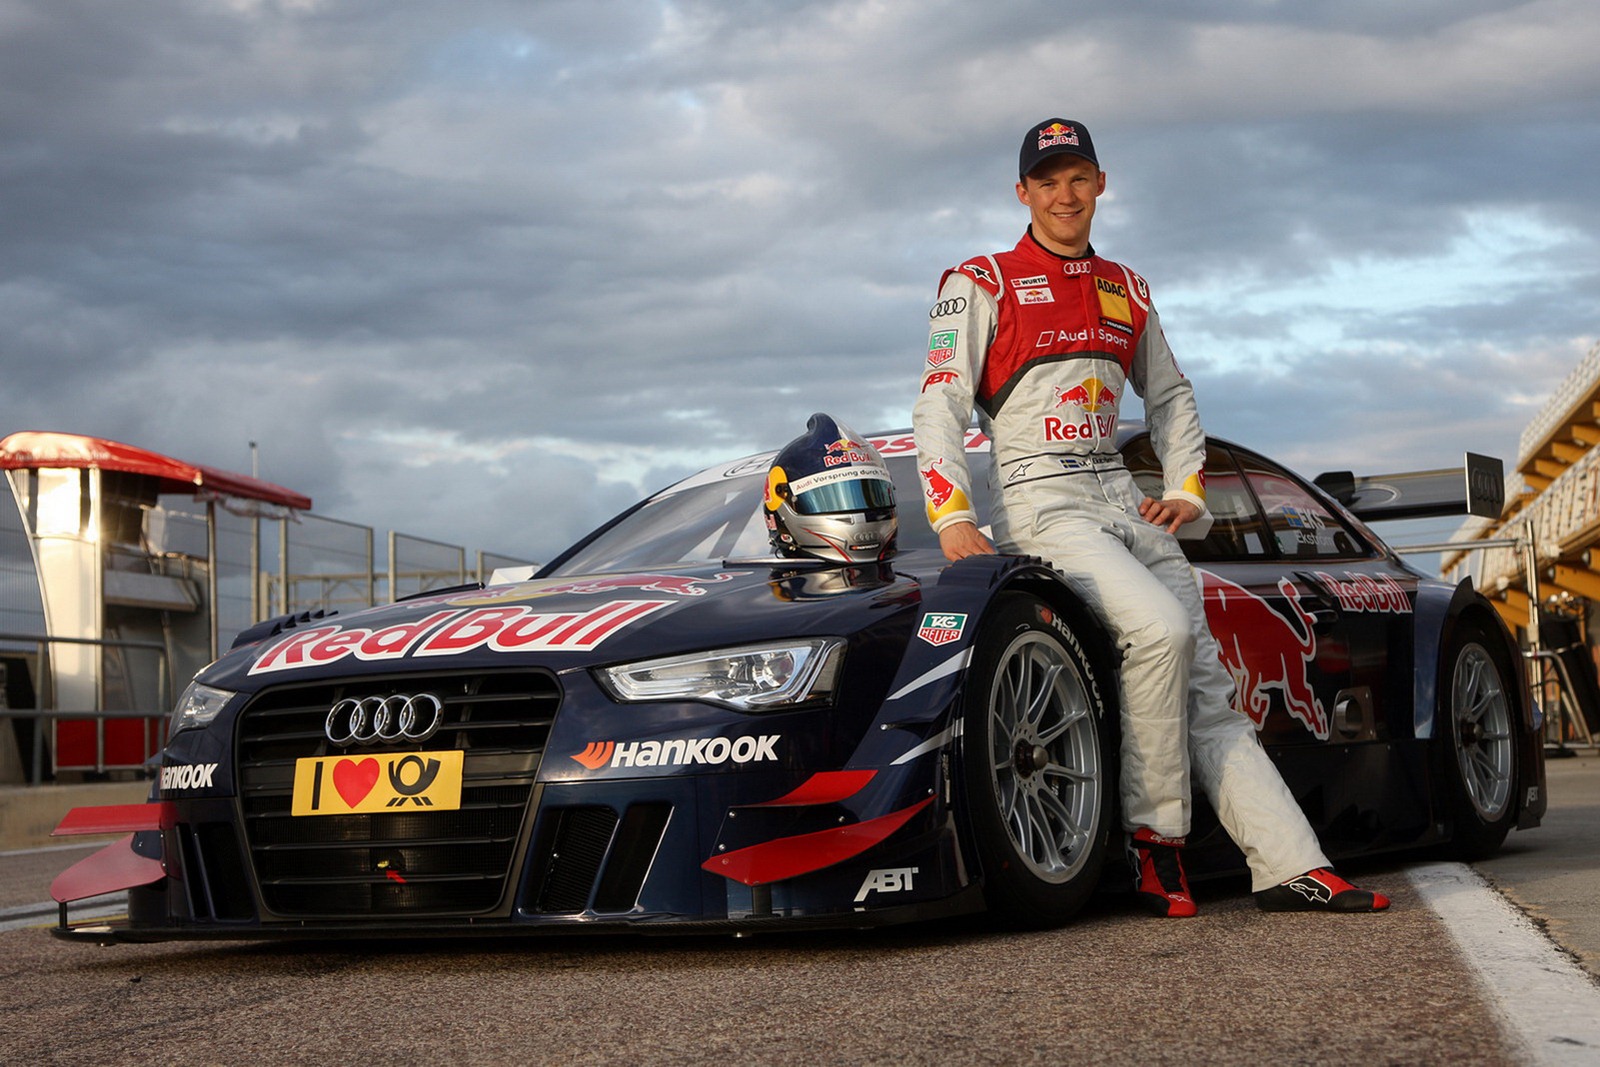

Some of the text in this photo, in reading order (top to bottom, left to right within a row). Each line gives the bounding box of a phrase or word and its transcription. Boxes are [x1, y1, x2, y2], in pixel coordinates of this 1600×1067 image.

[1038, 135, 1079, 149] Red Bull
[1097, 278, 1126, 298] ADAC
[1057, 328, 1128, 350] Audi Sport
[1044, 413, 1093, 441] Red
[824, 451, 871, 467] Red Bull
[796, 480, 812, 490] Audi
[813, 470, 859, 483] Vorsprung
[1297, 508, 1325, 529] EKS
[1315, 571, 1412, 613] Red Bull
[931, 615, 958, 628] TAG
[251, 601, 677, 673] Red Bull
[921, 629, 958, 643] HEUER
[311, 761, 324, 810] I
[854, 866, 914, 902] ABT
